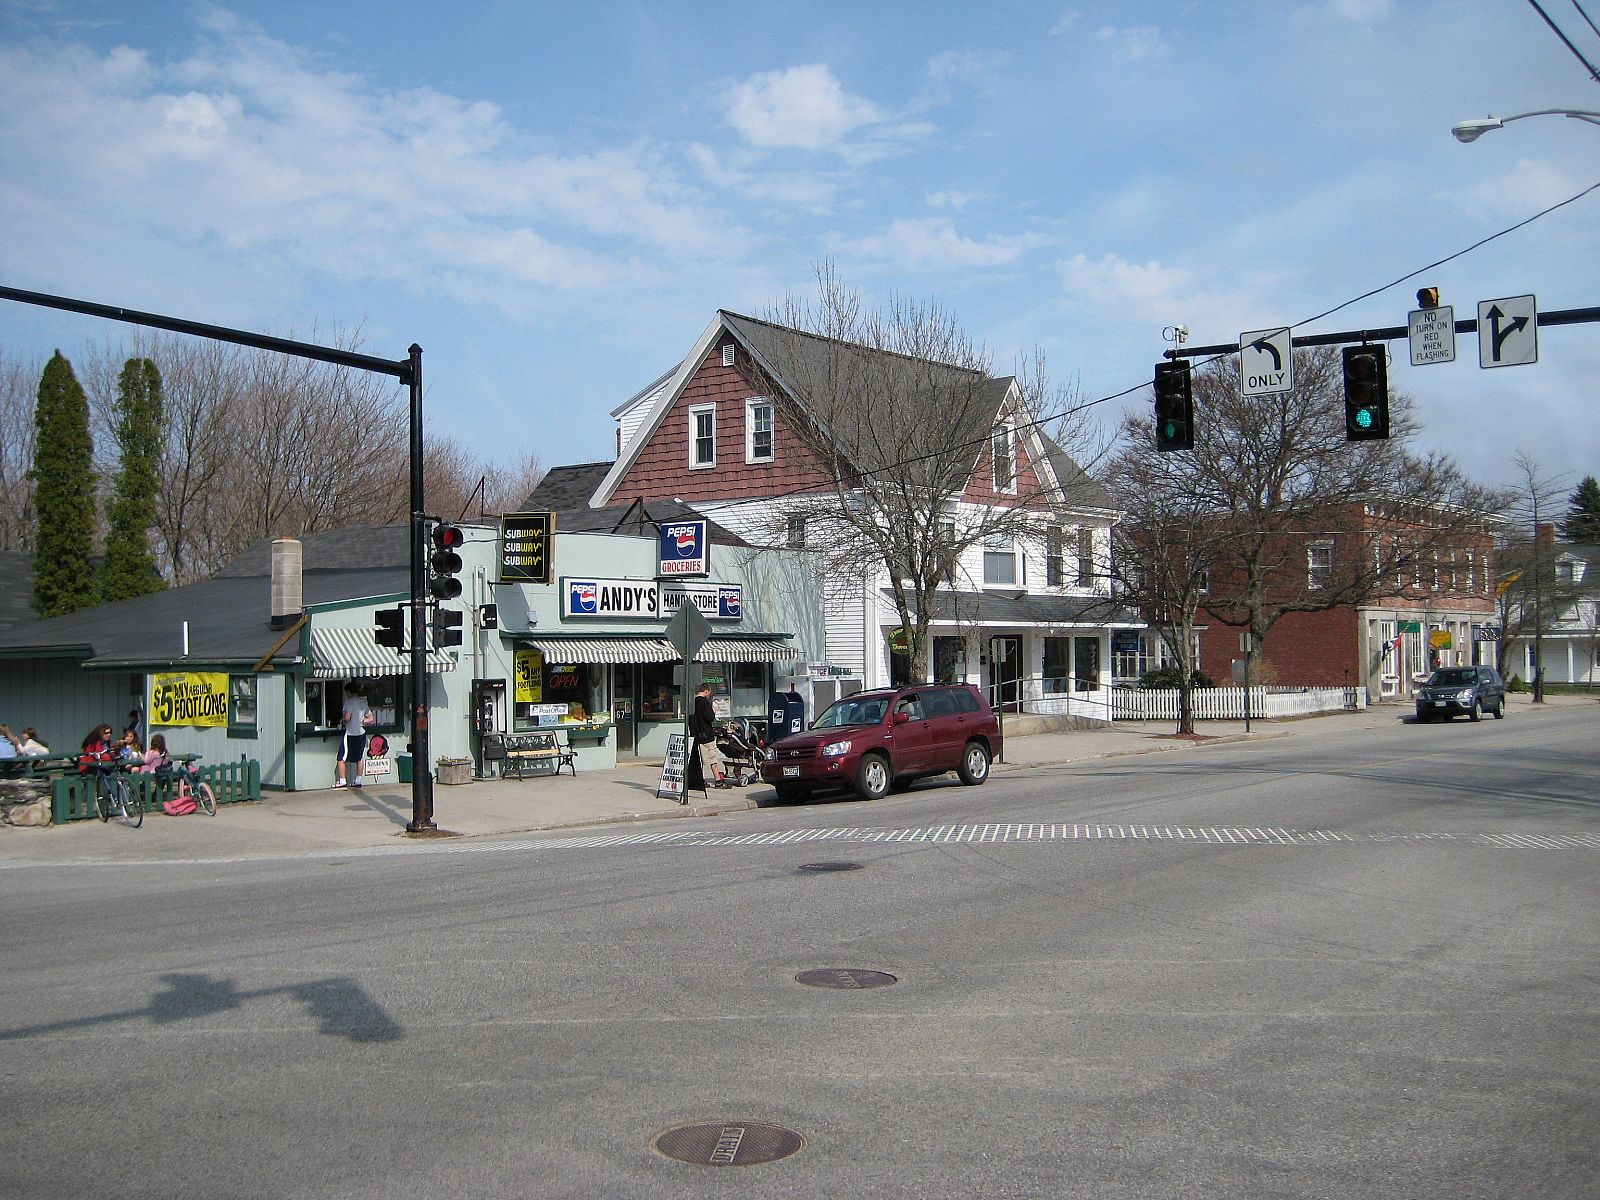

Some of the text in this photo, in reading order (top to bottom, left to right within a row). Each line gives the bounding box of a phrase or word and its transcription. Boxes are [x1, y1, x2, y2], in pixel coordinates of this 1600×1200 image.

[1424, 312, 1437, 323] NO
[1416, 321, 1448, 333] TURN ON
[1424, 332, 1439, 341] RED
[1423, 341, 1442, 351] WHEN
[1416, 350, 1449, 361] FLASHING
[1248, 372, 1285, 388] ONLY
[505, 529, 543, 539] SUBWAY
[667, 526, 696, 538] PEPSI
[504, 542, 543, 552] SUBWAY
[503, 555, 542, 566] SUBWAY
[662, 560, 701, 573] GROCERIES
[571, 584, 596, 594] PEPSI
[720, 590, 740, 600] PEPSI
[600, 586, 657, 612] ANDY'S
[693, 595, 717, 608] STORE
[516, 660, 531, 680] $5
[549, 674, 579, 689] OPEN
[174, 682, 212, 699] ANY REGULAR
[154, 685, 173, 722] $5
[174, 693, 227, 720] FOOTLONG
[539, 706, 551, 714] Post
[551, 705, 567, 713] Office
[616, 711, 625, 719] 67
[711, 1129, 743, 1161] DRAIN
